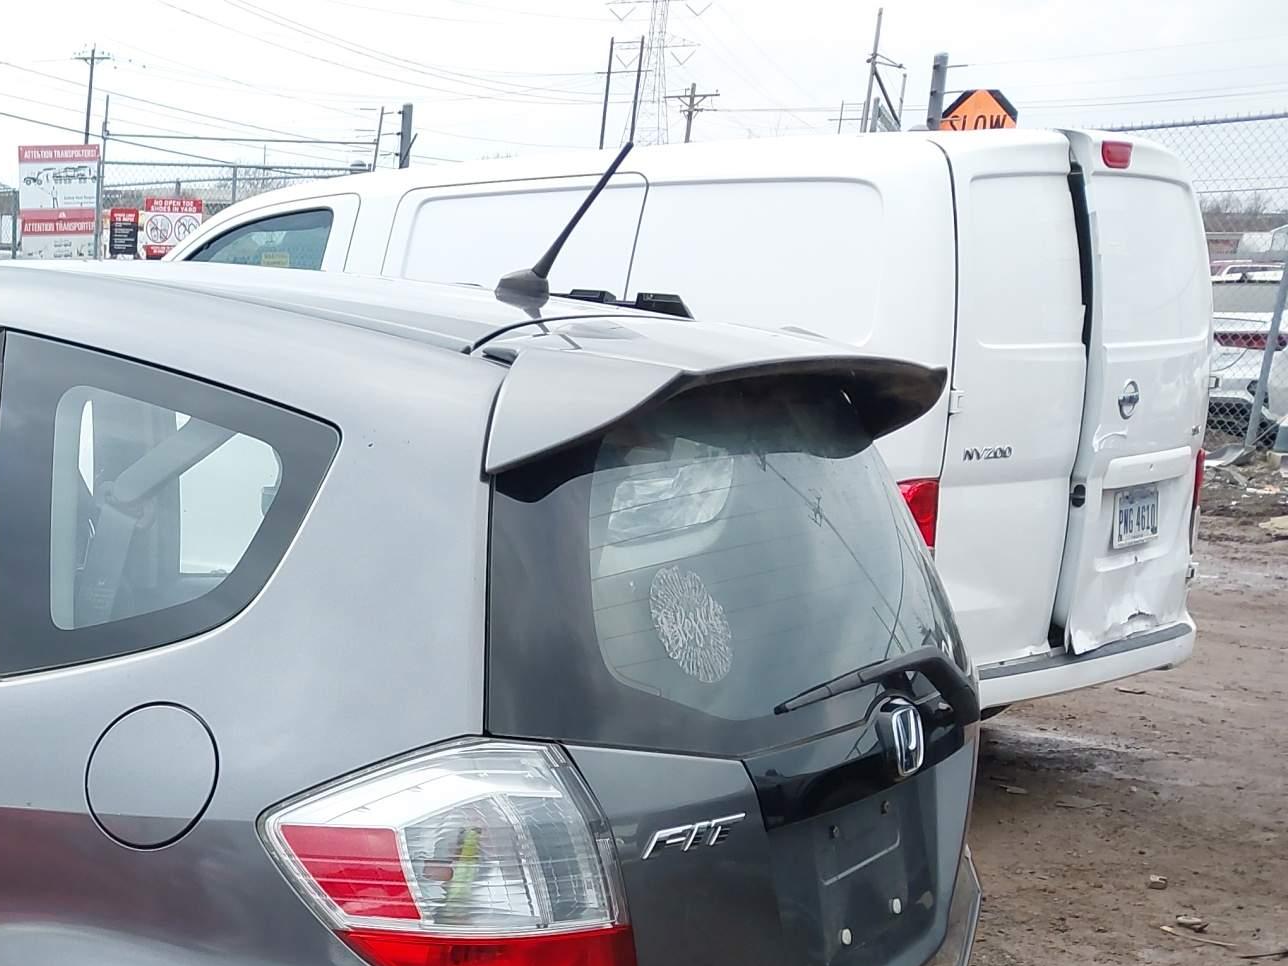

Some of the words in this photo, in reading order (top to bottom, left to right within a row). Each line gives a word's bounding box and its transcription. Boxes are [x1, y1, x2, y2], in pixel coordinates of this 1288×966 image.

[24, 149, 53, 160] ATTENTION
[24, 222, 55, 232] ATTENTION
[962, 446, 1013, 461] NV200
[1118, 507, 1134, 536] PNG
[1136, 503, 1156, 532] 4610
[641, 812, 747, 861] FIT
